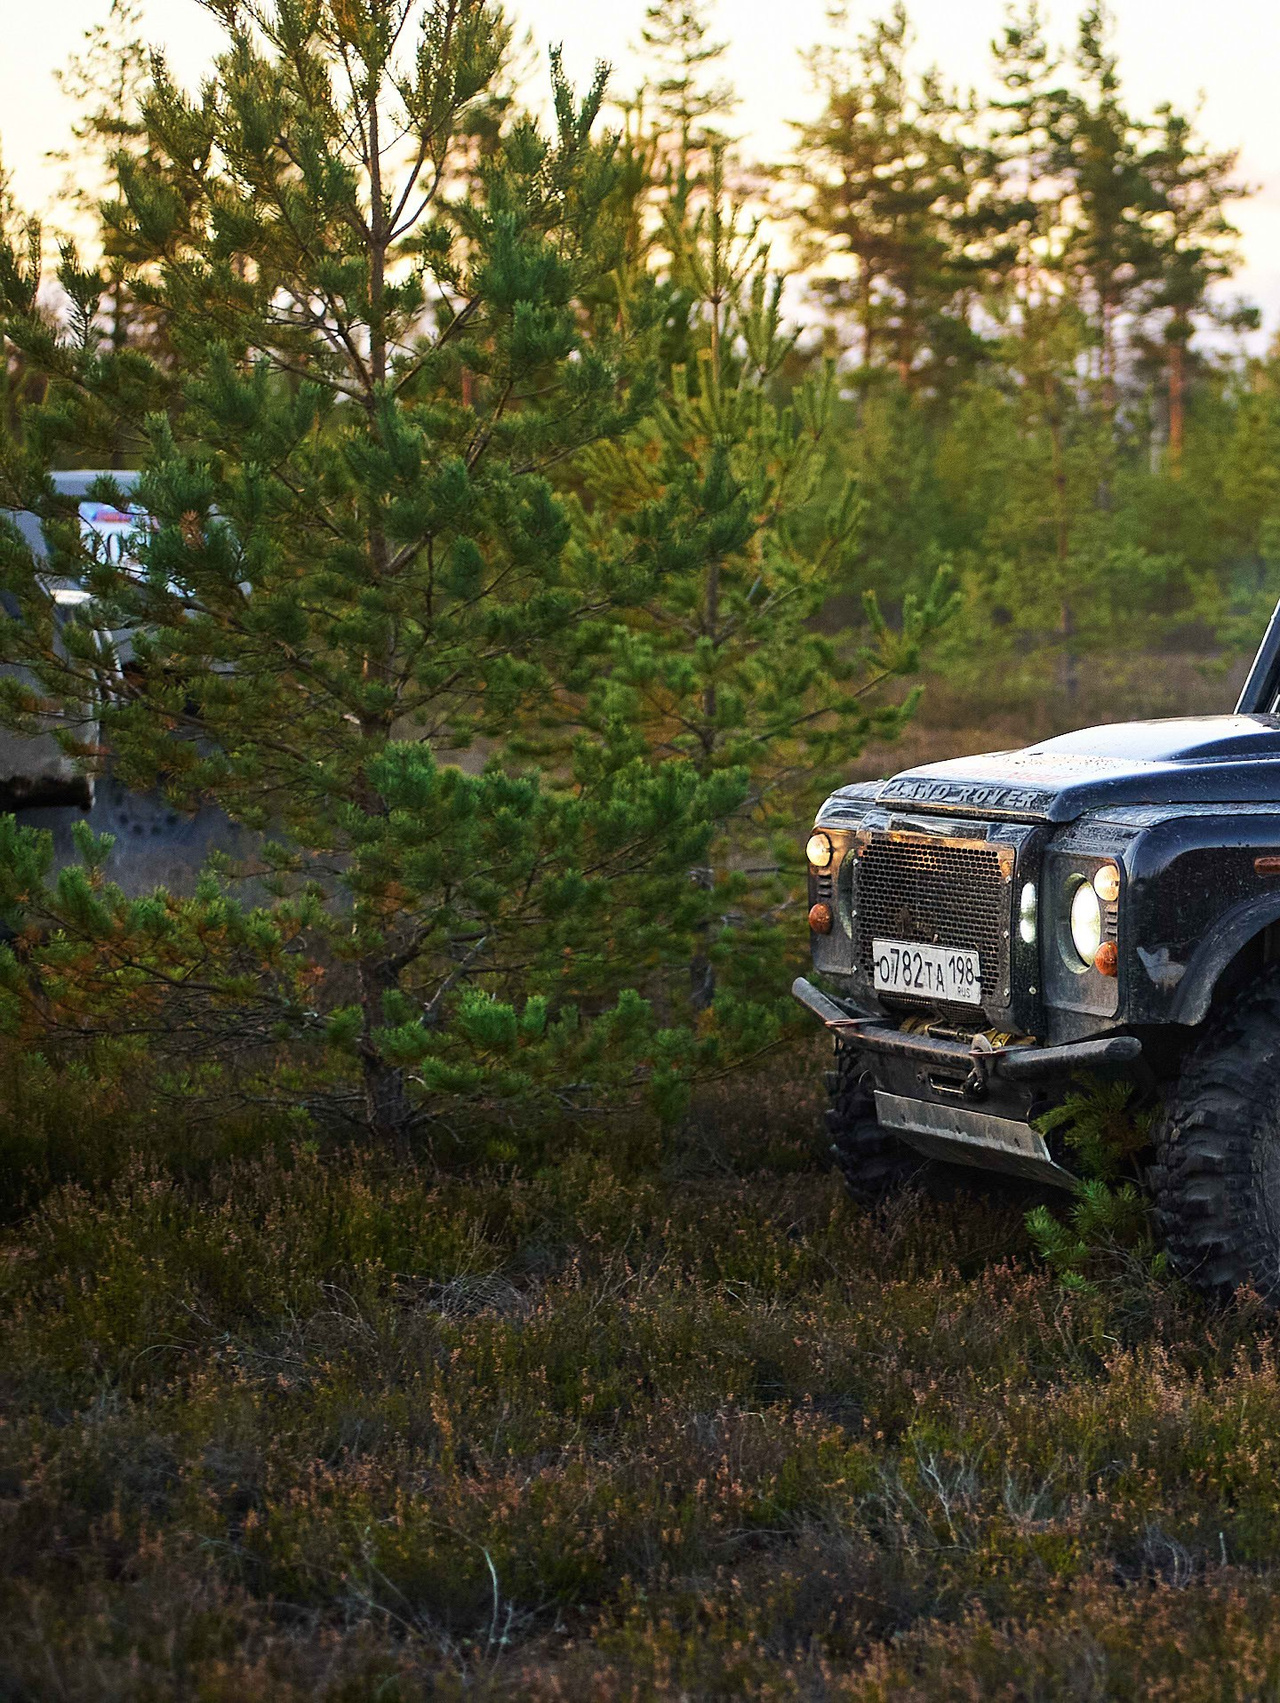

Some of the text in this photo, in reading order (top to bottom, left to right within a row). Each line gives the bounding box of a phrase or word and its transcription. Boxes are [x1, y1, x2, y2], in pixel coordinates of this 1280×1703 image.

[890, 780, 1038, 808] LAND ROVER
[948, 955, 975, 986] 198
[957, 986, 971, 998] RUS
